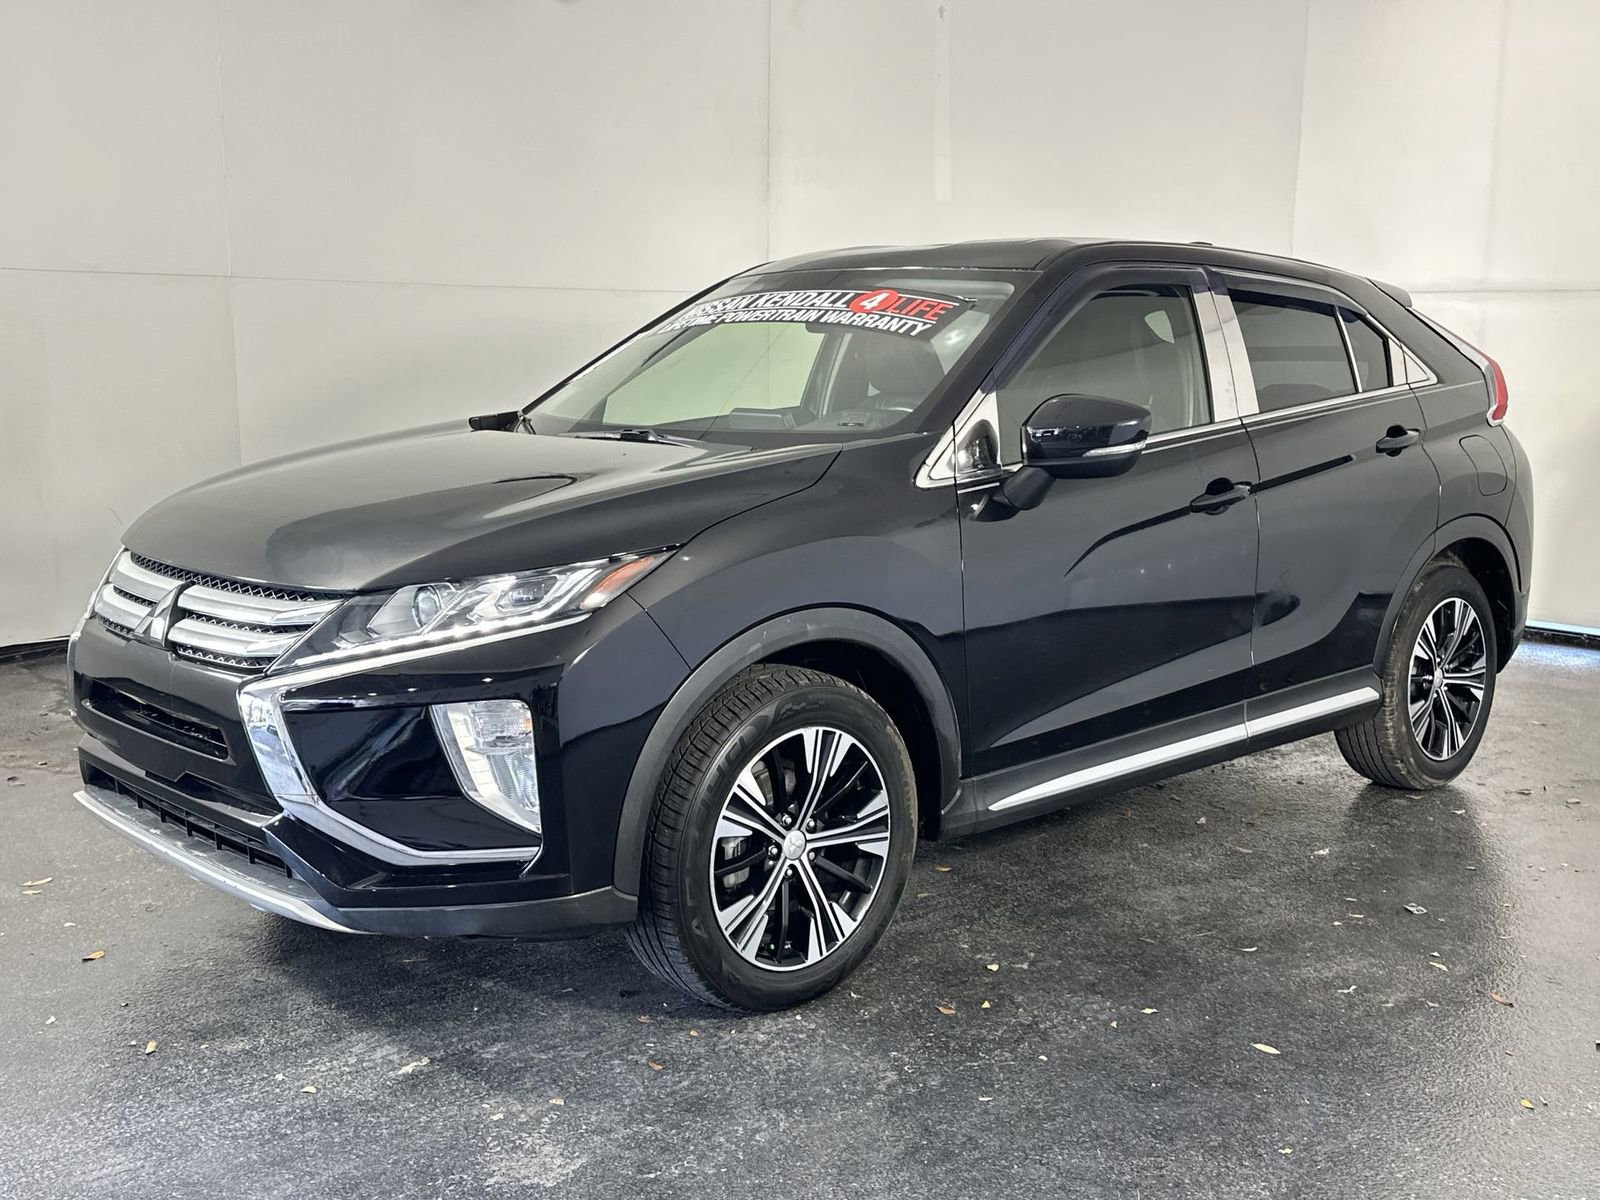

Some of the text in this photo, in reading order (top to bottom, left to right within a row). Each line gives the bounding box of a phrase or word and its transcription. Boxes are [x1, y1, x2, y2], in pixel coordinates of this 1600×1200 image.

[749, 292, 855, 308] KENDALL
[859, 292, 890, 310] 4
[886, 297, 954, 320] LIFE
[714, 309, 825, 324] POWERTRAIN
[819, 310, 932, 337] WARRANTY
